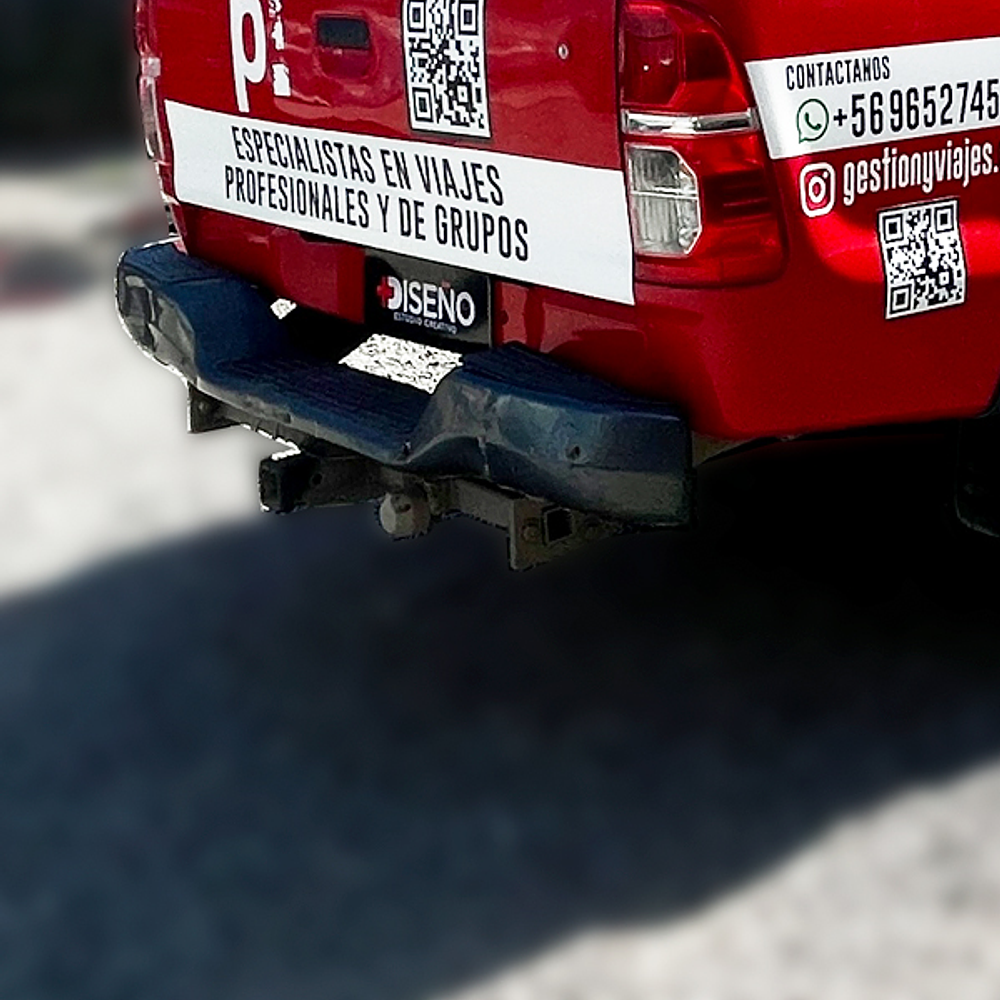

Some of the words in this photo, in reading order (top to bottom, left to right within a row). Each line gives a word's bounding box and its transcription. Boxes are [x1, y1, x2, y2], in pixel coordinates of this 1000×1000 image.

[786, 55, 890, 91] CONTACTANOS
[231, 125, 376, 184] ESPECIALISTAS
[380, 149, 411, 190] EN
[415, 154, 504, 206] VIAJES
[225, 165, 369, 229] PROFESIONALES
[377, 193, 390, 233] Y
[399, 197, 426, 241] DE
[435, 204, 529, 262] GRUPOS
